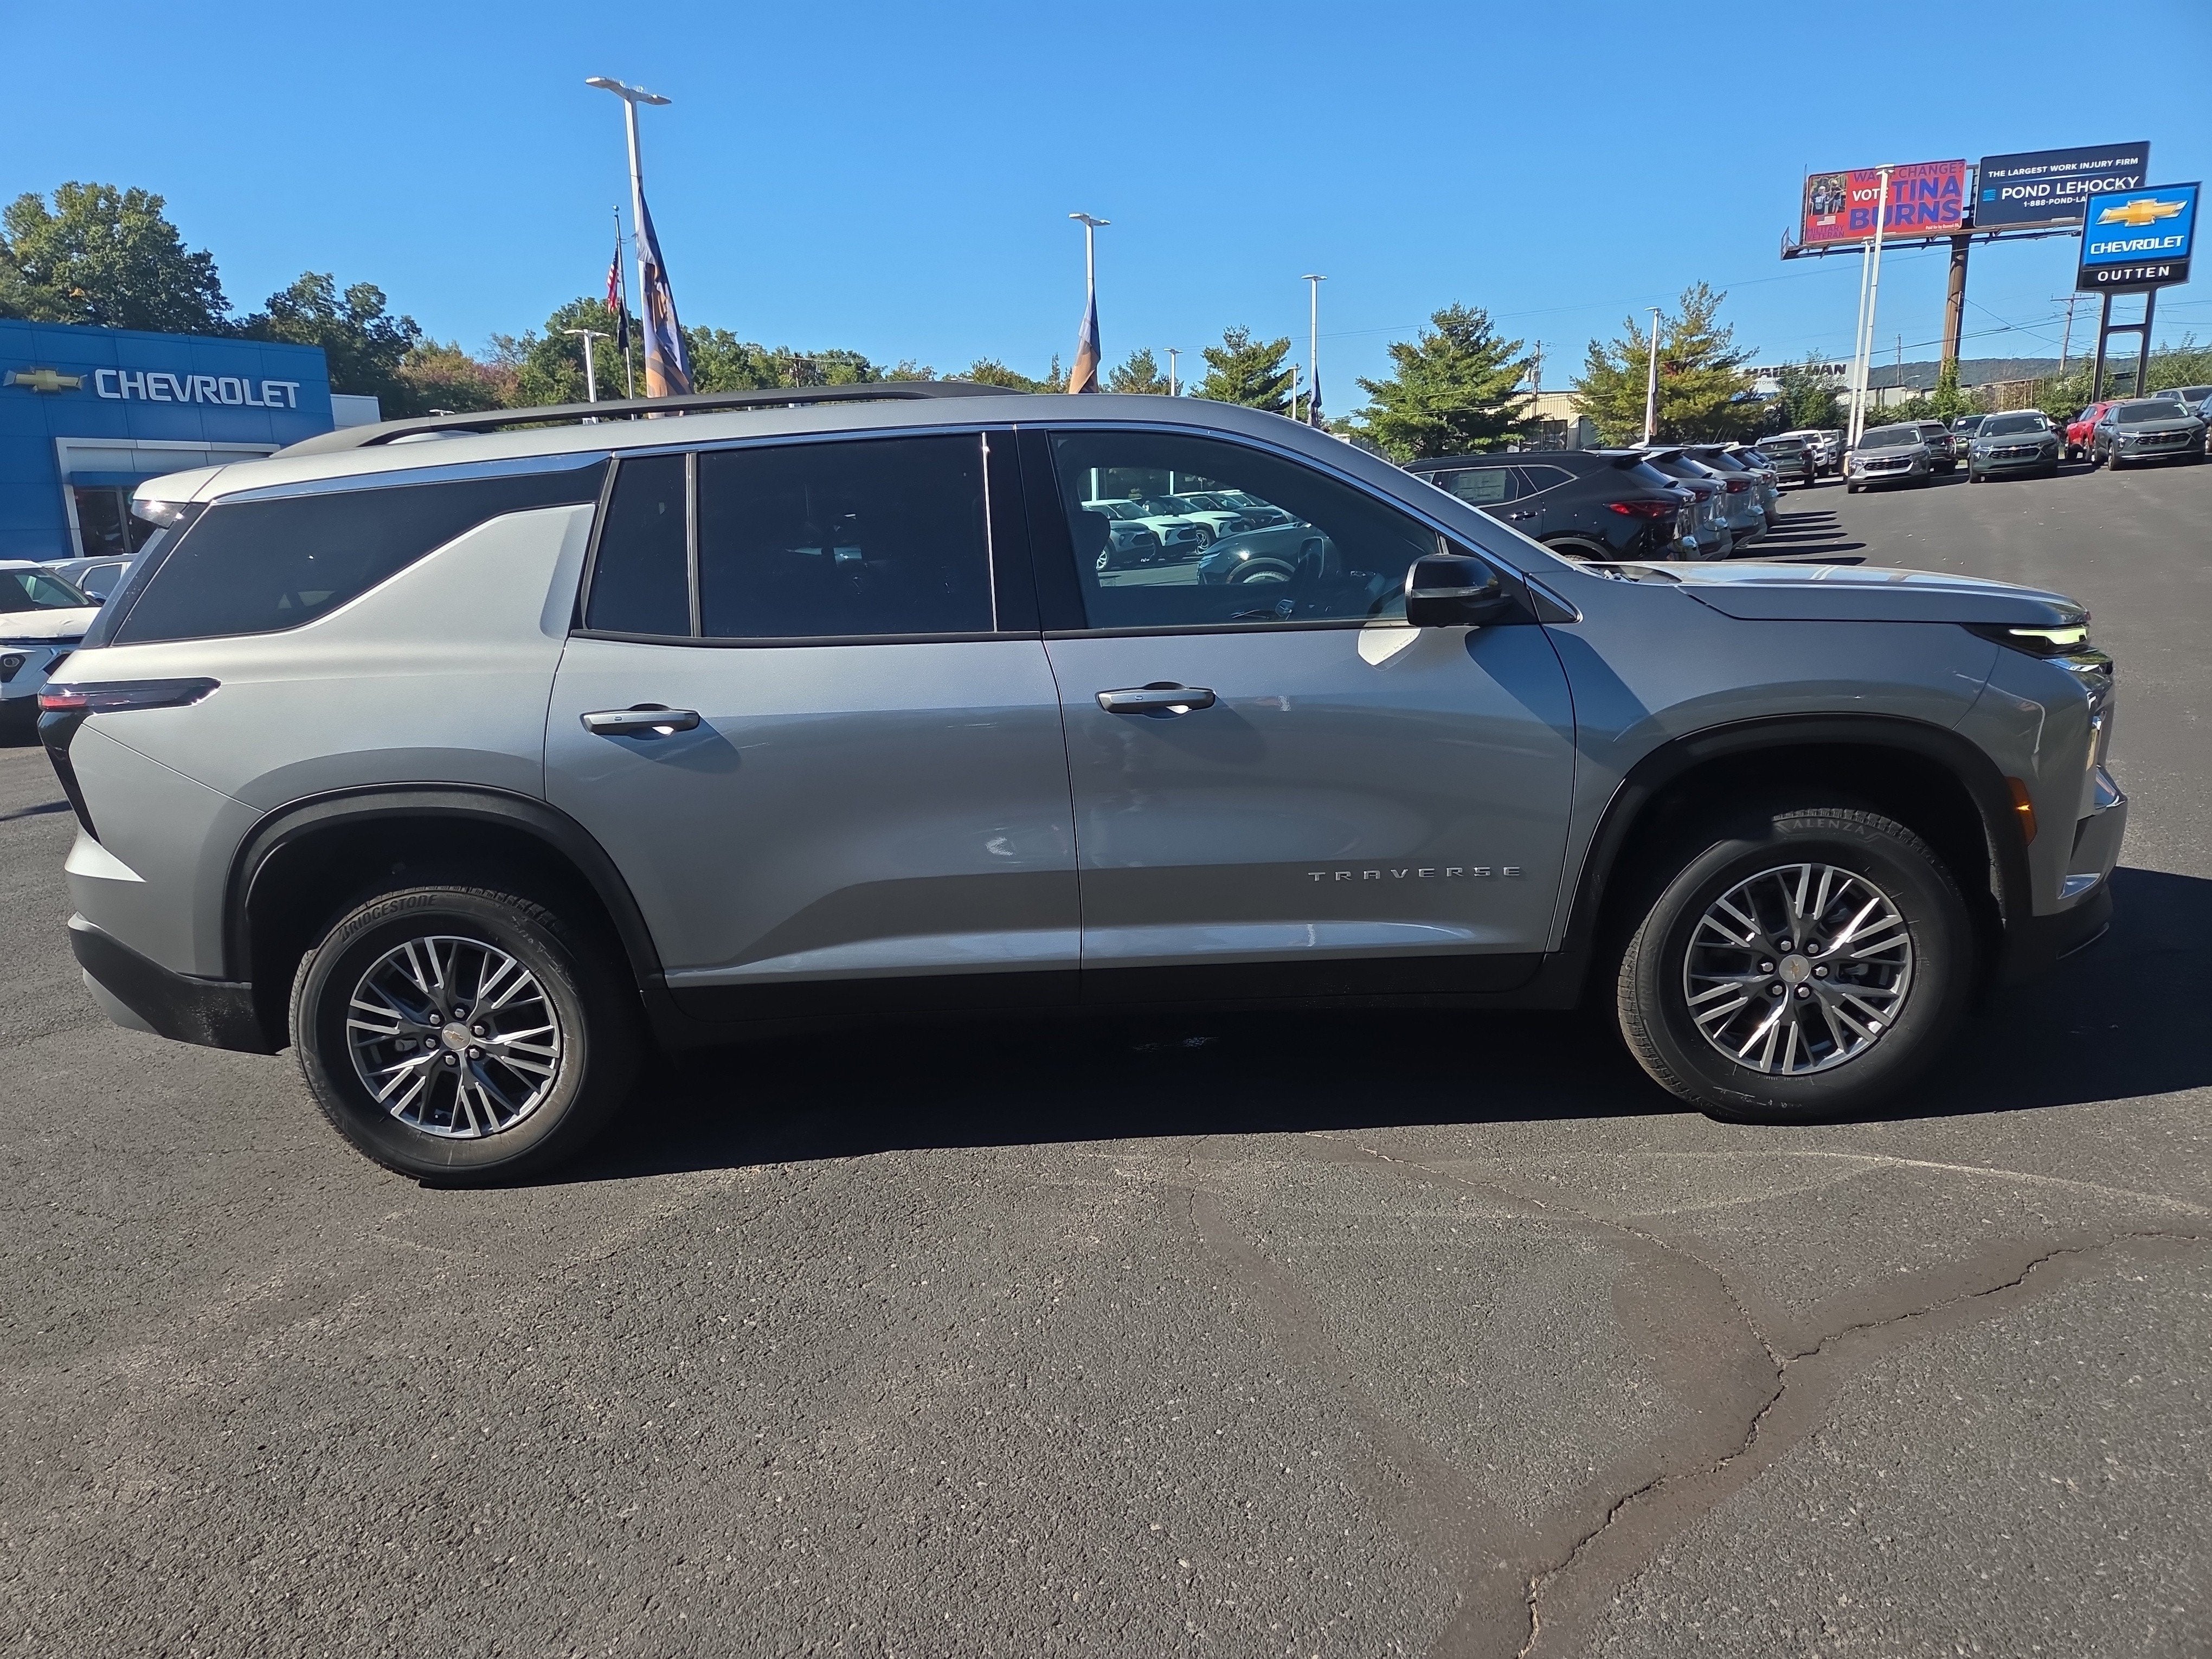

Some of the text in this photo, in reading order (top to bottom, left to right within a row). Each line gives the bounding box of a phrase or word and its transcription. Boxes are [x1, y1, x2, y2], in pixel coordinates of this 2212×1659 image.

[1899, 163, 1964, 178] CHANGE?
[2008, 166, 2048, 176] LARGEST
[2050, 163, 2078, 172] WORK
[2080, 159, 2114, 170] INJURY
[2115, 157, 2138, 166] FIRM
[1852, 176, 1962, 203] VOT TINA
[2002, 176, 2139, 200] POND LEHOCKY
[2023, 196, 2086, 208] 1-888-POND-LA
[1849, 199, 1962, 231] BURNS
[2090, 235, 2185, 255] CHEVROLET
[2097, 266, 2170, 282] OUTTEN
[94, 369, 300, 408] CHEVROLET
[1793, 819, 1865, 835] ALENZA
[1308, 866, 1521, 882] TRAVERSE
[337, 894, 438, 942] BRIDGESTONE
